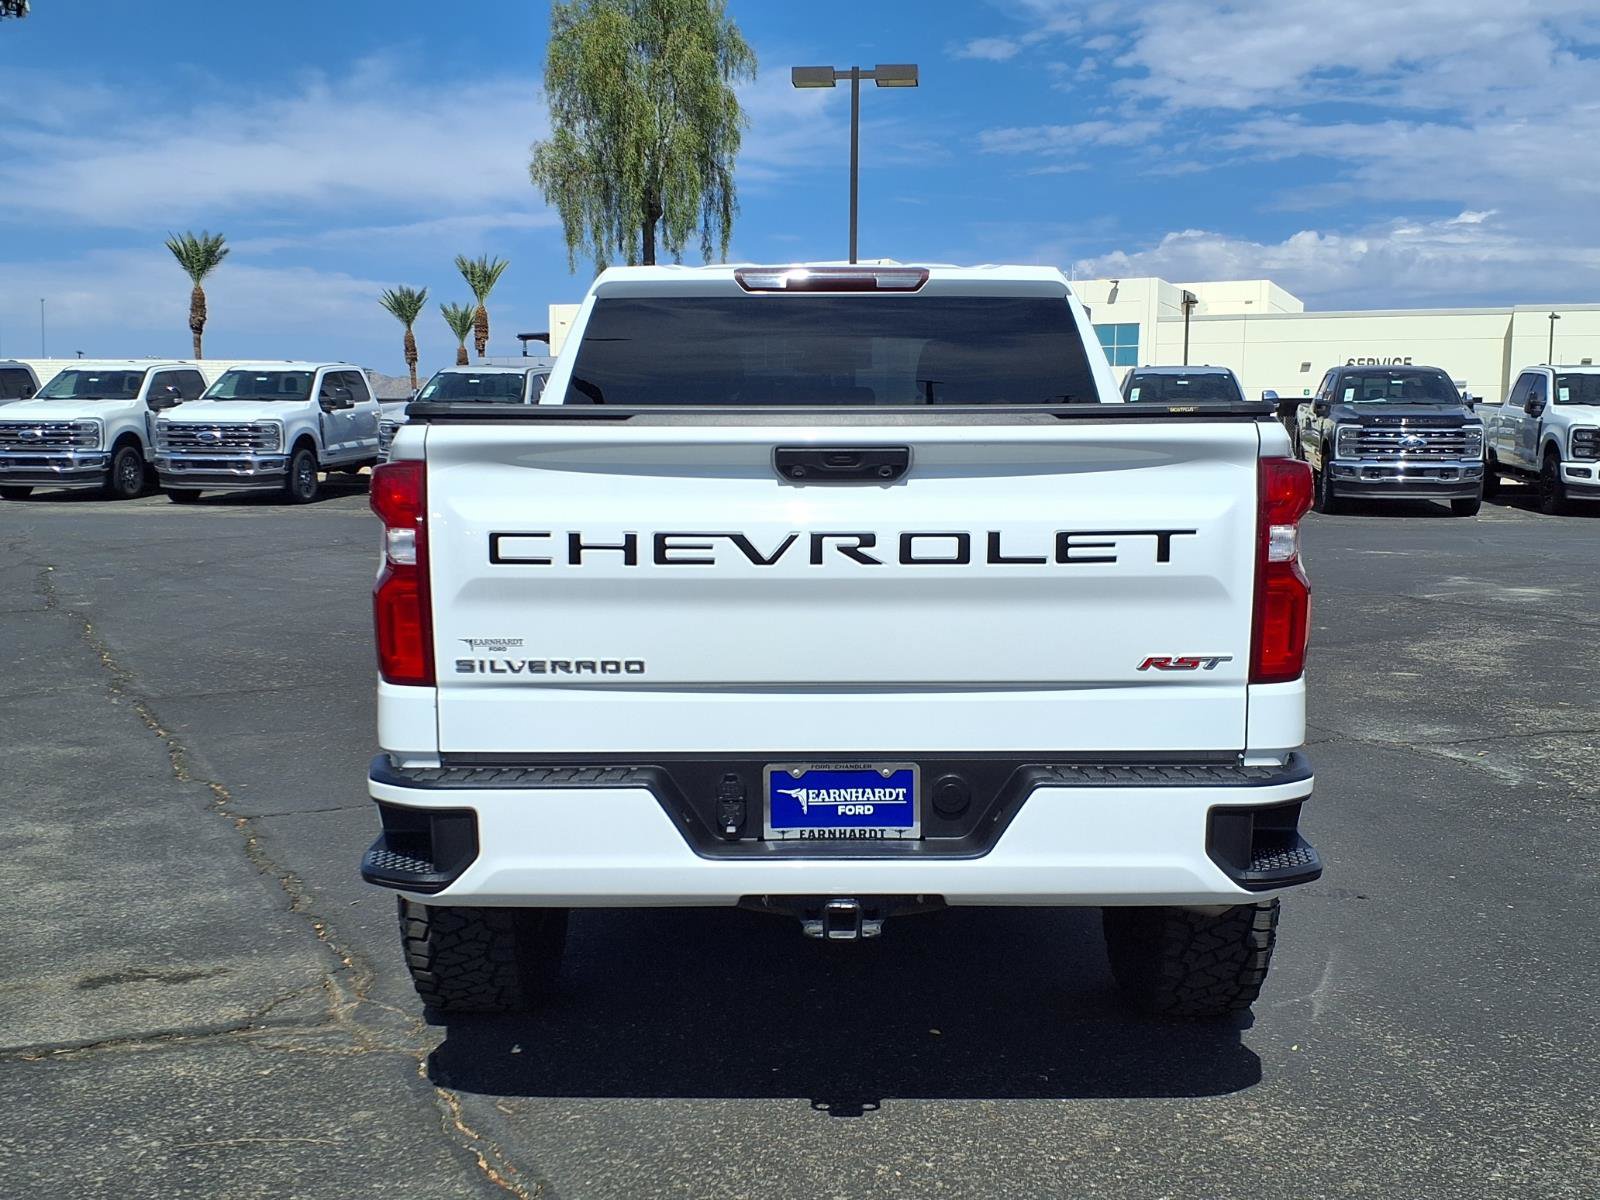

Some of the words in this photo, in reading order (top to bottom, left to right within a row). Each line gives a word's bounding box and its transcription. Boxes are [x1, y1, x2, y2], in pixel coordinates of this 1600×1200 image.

[488, 529, 1198, 566] CHEVROLET
[473, 638, 524, 646] EARNHARDT
[455, 659, 646, 674] SILVERADO
[1136, 656, 1233, 671] RST
[808, 788, 907, 801] EARNHARDT
[837, 804, 874, 815] FORD
[800, 828, 887, 839] EARNHARDT
